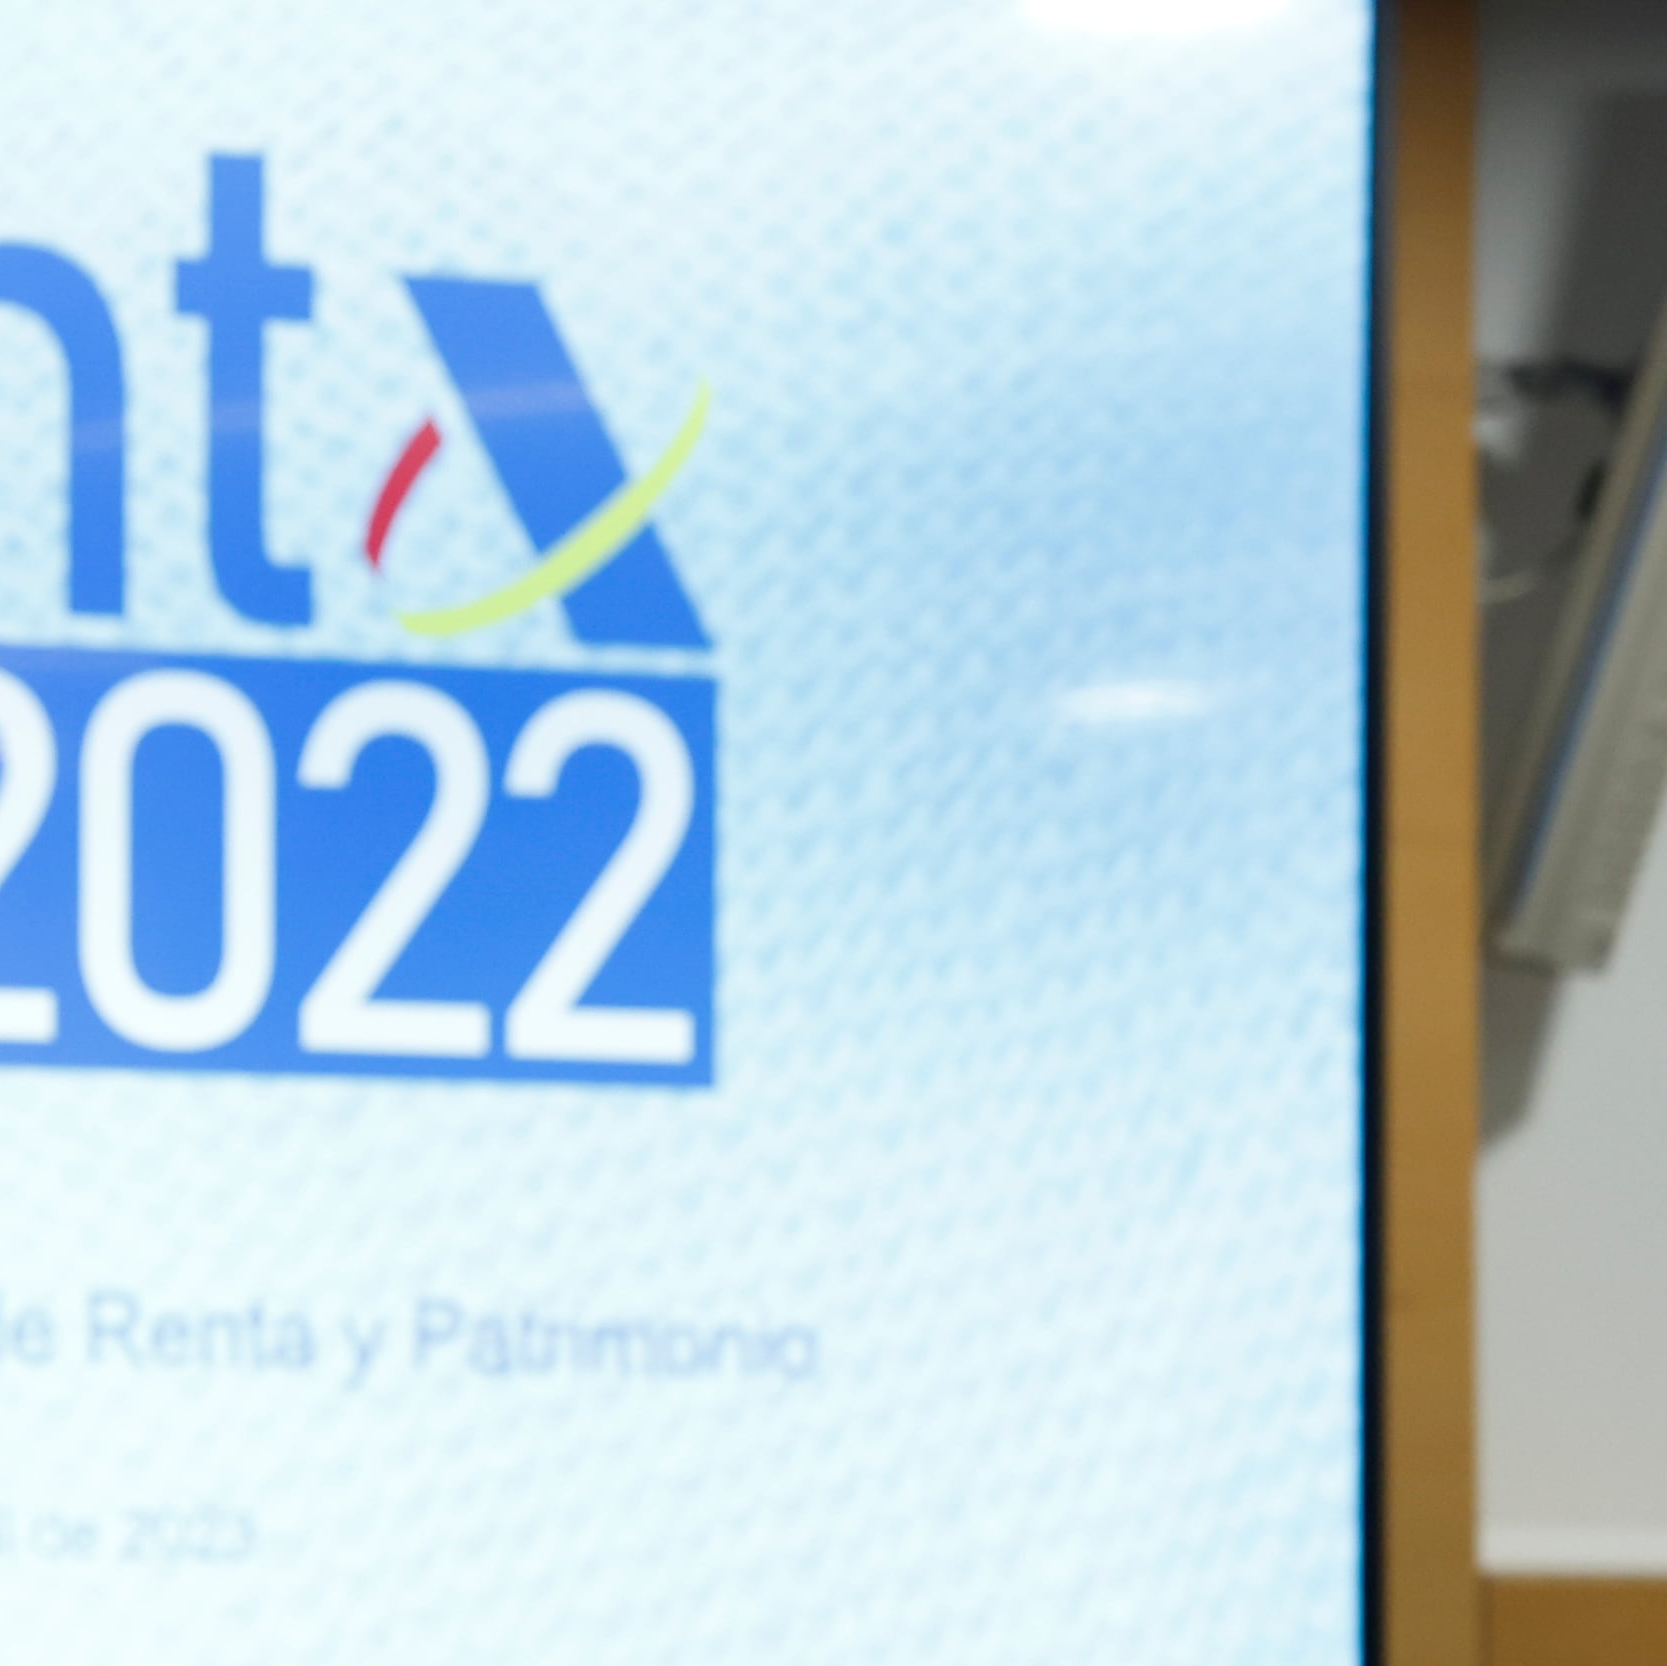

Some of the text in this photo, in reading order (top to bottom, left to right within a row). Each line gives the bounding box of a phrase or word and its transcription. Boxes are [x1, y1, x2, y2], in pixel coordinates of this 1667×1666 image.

[87, 1289, 319, 1372] Renta
[342, 1314, 385, 1389] y
[413, 1296, 822, 1382] Patrimonio
